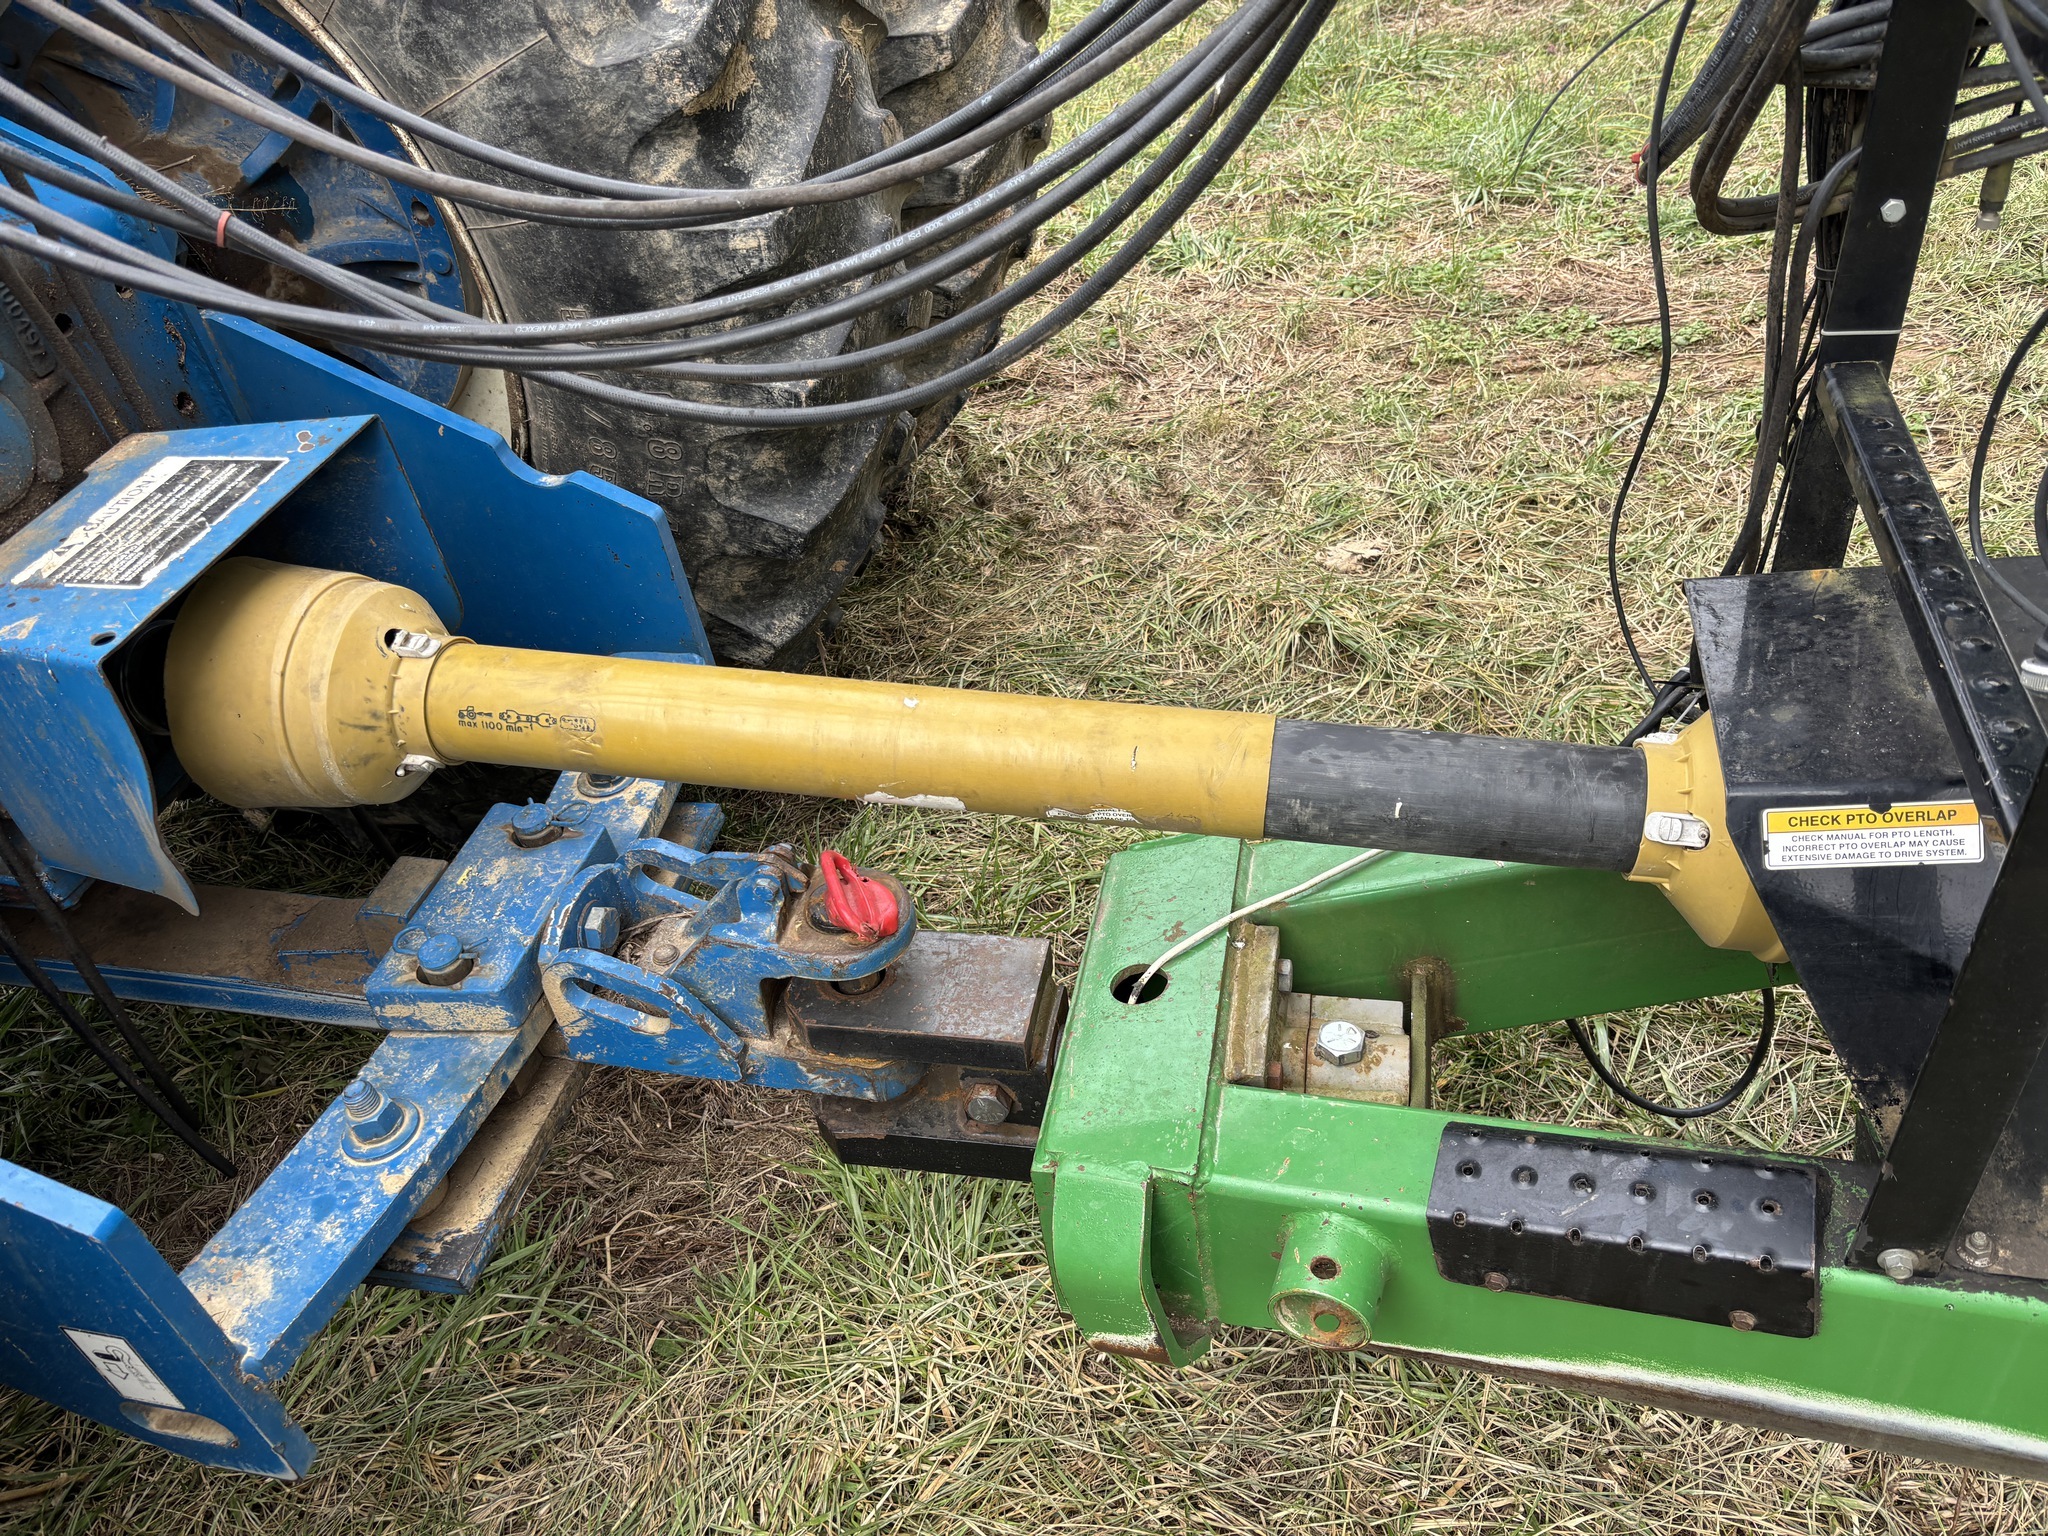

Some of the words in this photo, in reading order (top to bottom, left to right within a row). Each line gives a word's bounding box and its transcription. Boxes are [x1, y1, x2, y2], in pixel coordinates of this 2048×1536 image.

[83, 480, 155, 532] CAUTION
[458, 720, 478, 728] max
[481, 721, 503, 731] 1100
[1788, 814, 1840, 827] CHECK
[1846, 812, 1877, 824] PTO
[1882, 809, 1957, 823] OVERLAP
[1791, 834, 1824, 842] CHECK
[1826, 833, 1866, 841] MANUAL
[1869, 831, 1890, 839] FOR
[1914, 829, 1955, 838] LENGTH.
[1782, 843, 1836, 852] INCORRECT
[1839, 842, 1858, 850] PTO
[1861, 840, 1906, 849] OVERLAP
[1909, 839, 1930, 847] MAY
[1932, 838, 1966, 847] CAUSE
[1781, 853, 1832, 862] EXTENSIVE
[1835, 852, 1876, 860] DAMAGE
[1879, 851, 1892, 859] TO
[1895, 849, 1923, 858] DRIVE
[1926, 848, 1967, 857] SYSTEM.
